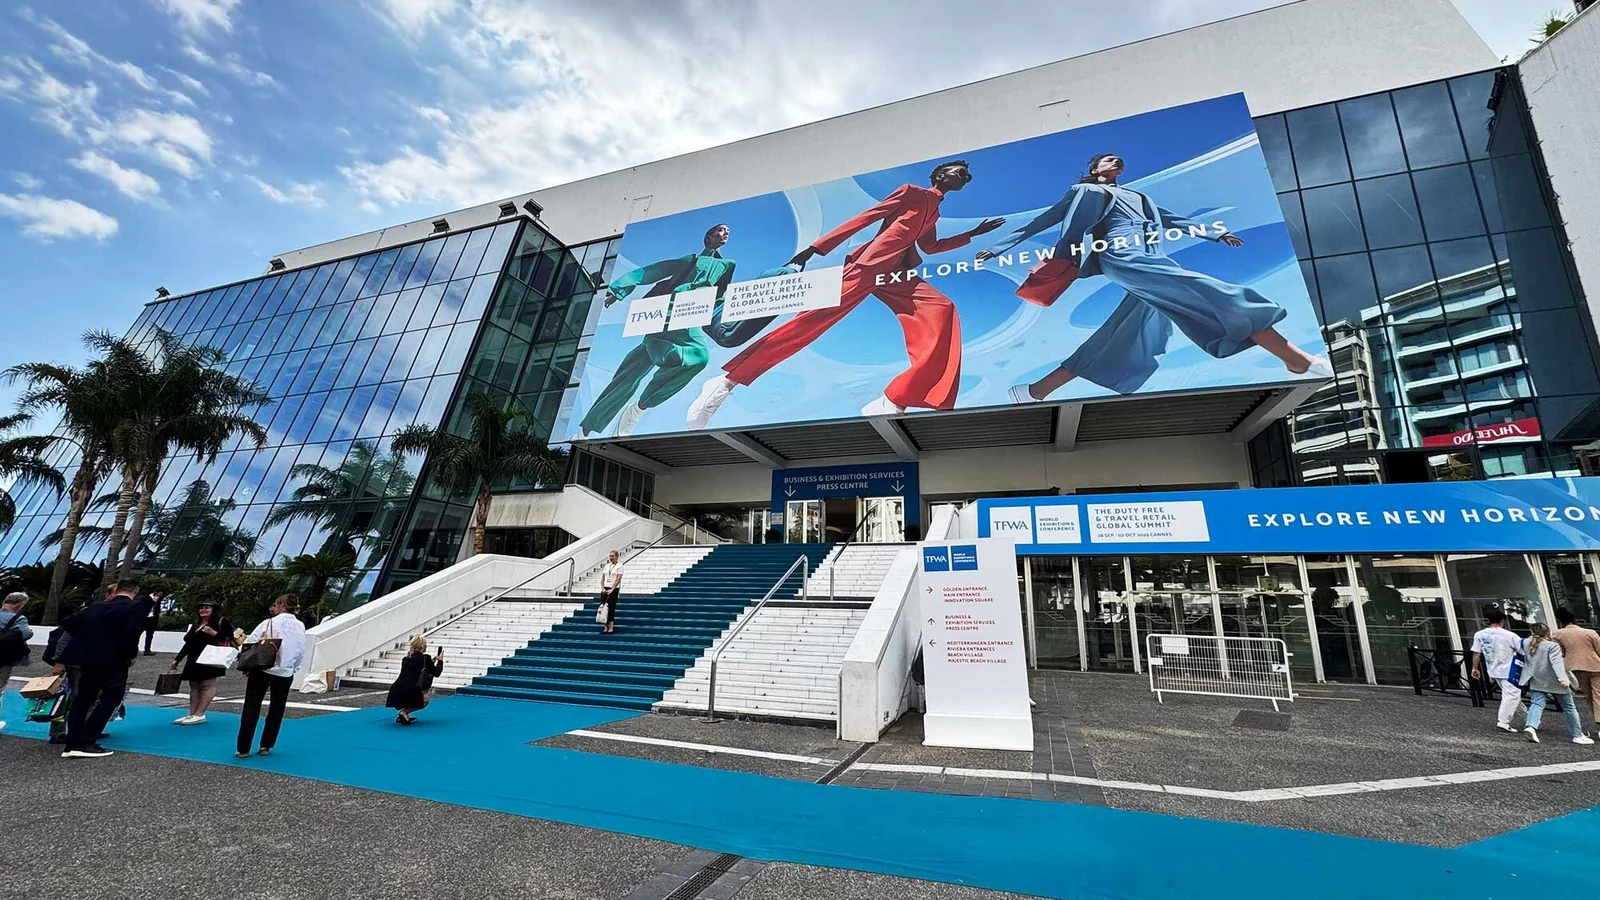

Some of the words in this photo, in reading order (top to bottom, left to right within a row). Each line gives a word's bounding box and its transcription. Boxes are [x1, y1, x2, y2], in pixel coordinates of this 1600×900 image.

[875, 258, 986, 286] EXPLORE
[998, 246, 1056, 268] NEW
[1070, 220, 1228, 256] HORIZONS
[733, 284, 750, 294] THE
[753, 281, 778, 291] DUTY
[780, 276, 803, 286] FREE
[741, 289, 776, 300] TRAVEL
[779, 282, 813, 293] RETAIL
[730, 297, 766, 308] GLOBAL
[769, 291, 806, 303] SUMMIT
[781, 301, 804, 309] CANNES
[631, 309, 663, 323] TFWA
[673, 309, 709, 318] CONFERENCE
[784, 476, 817, 484] BUSINESS
[825, 473, 868, 481] EXHIBITION
[869, 471, 905, 479] SERVICES
[840, 482, 869, 490] CENTRE
[1247, 511, 1371, 527] EXPLORE
[1383, 509, 1447, 525] NEW
[994, 520, 1028, 530] TFWA
[1135, 521, 1171, 529] SUMMIT
[925, 555, 947, 563] TFWA
